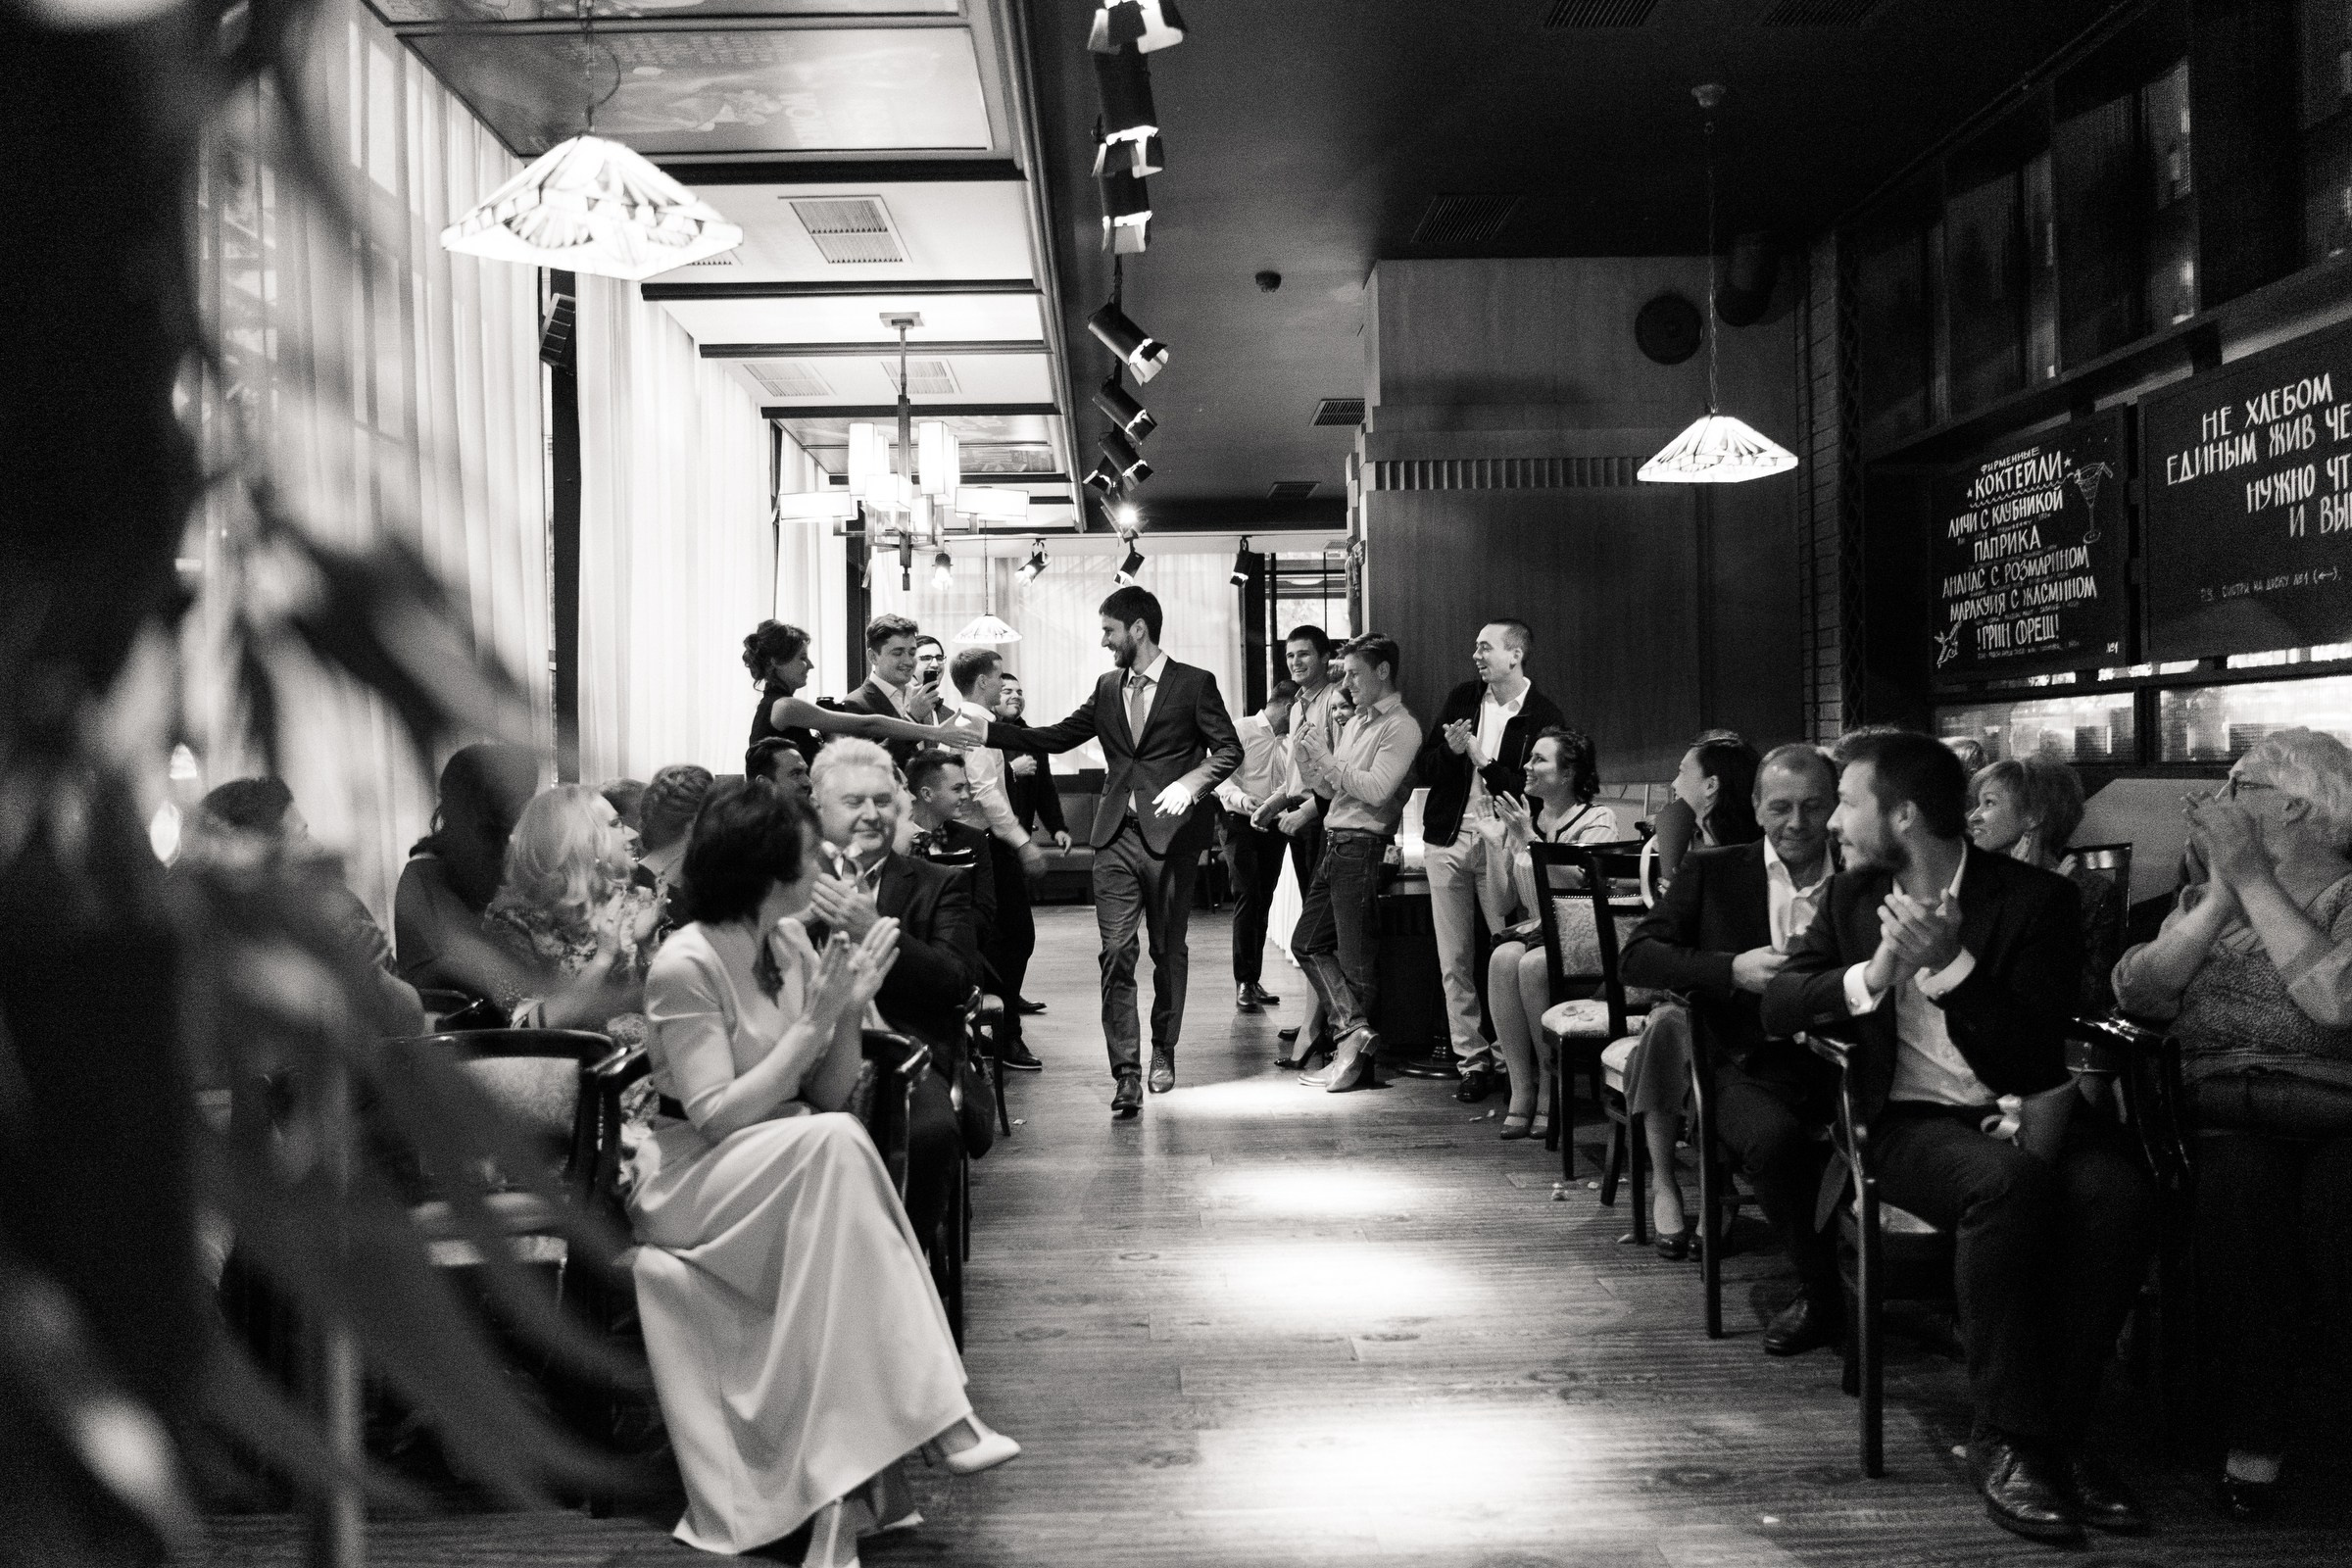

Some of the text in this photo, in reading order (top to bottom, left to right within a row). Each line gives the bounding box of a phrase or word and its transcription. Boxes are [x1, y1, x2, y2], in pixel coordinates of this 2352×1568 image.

[2202, 372, 2333, 442] НЕ ХЛЕБОМ
[1981, 446, 2040, 474] ФИРМЕННЫЕ
[2167, 403, 2352, 486] ЕДИНЫМ ЖИВ ЧЕ
[1975, 450, 2062, 501] КОКТЕЙЛИ
[2246, 453, 2352, 514] НУЖНО ЧТ
[1947, 512, 1978, 539] ЛИЧИ
[1981, 509, 1989, 530] С
[1991, 485, 2063, 526] КЛУБНИКОЙ
[2289, 504, 2304, 537] И
[1974, 524, 2041, 564] ПАПРИКА
[1942, 568, 1985, 599] АНАНАС
[1990, 565, 1999, 586] С
[2004, 545, 2089, 583] РОЗМАРИНОМ
[2011, 588, 2020, 609] С
[2023, 575, 2097, 607] ЖАСМИНОМ
